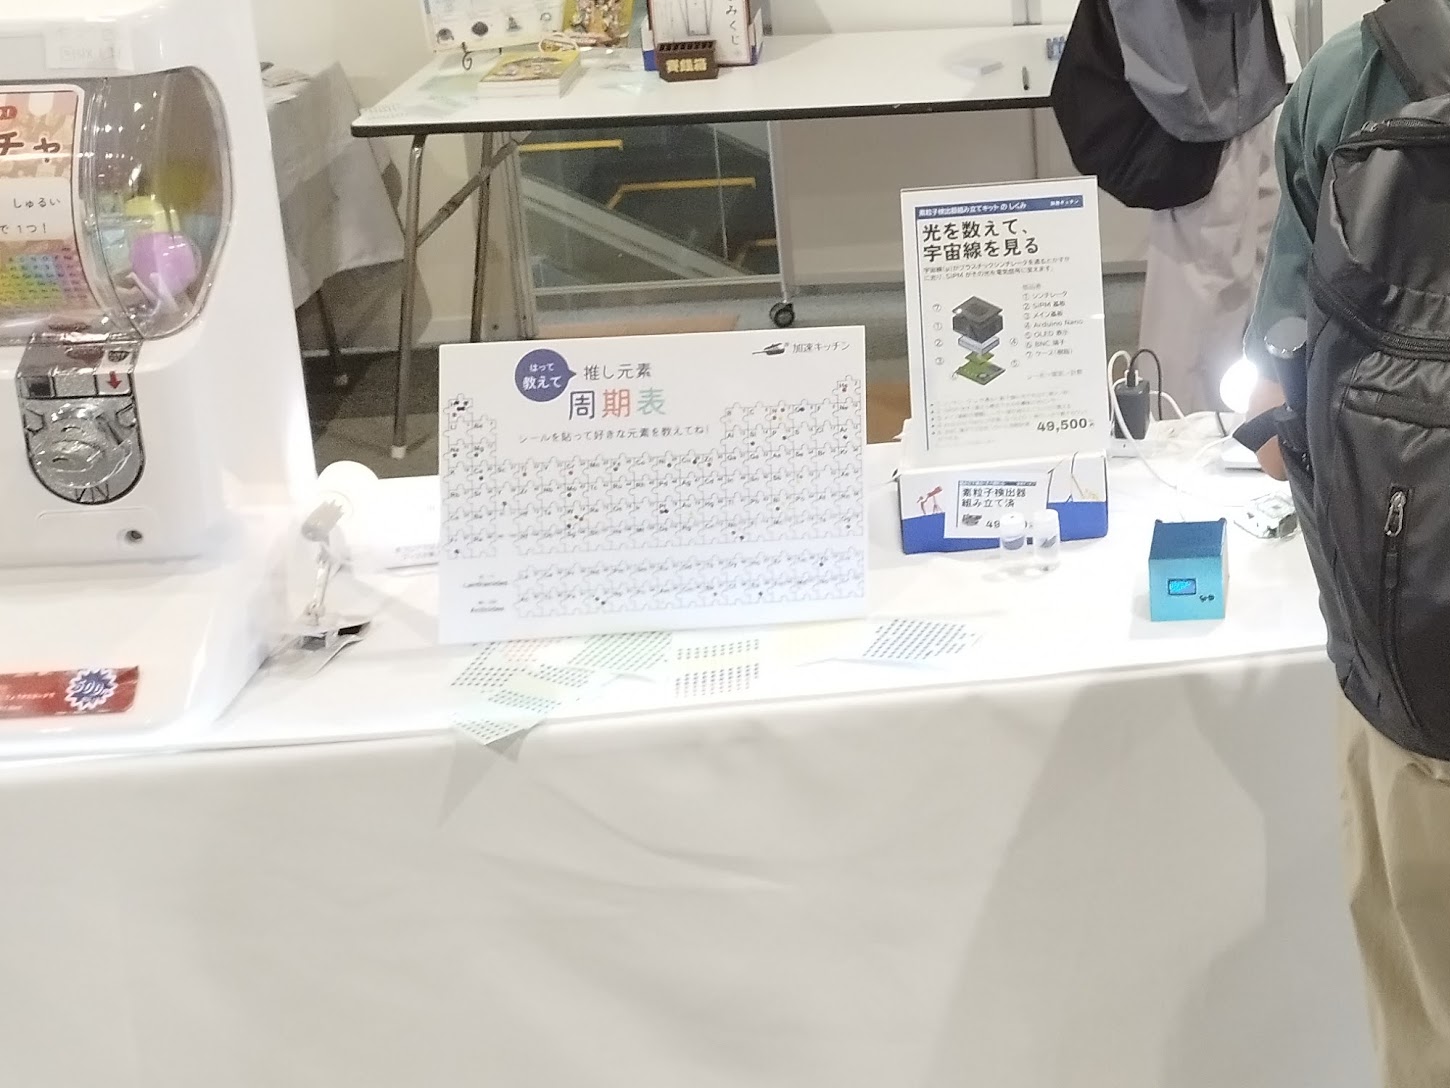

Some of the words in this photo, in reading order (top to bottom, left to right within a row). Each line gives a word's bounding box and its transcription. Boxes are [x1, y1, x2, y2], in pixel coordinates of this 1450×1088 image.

[13, 197, 61, 209] しゅるい
[923, 218, 1028, 243] 光を数えて、
[923, 237, 1039, 262] 宇宙線を見る
[792, 341, 849, 353] 加速キッチン
[530, 362, 554, 372] はって
[584, 363, 652, 381] 推し元素
[523, 375, 562, 390] 教えて
[569, 387, 666, 421] 周期表
[962, 488, 1026, 497] 素粒子検出器
[962, 499, 1015, 508] 組み立て済
